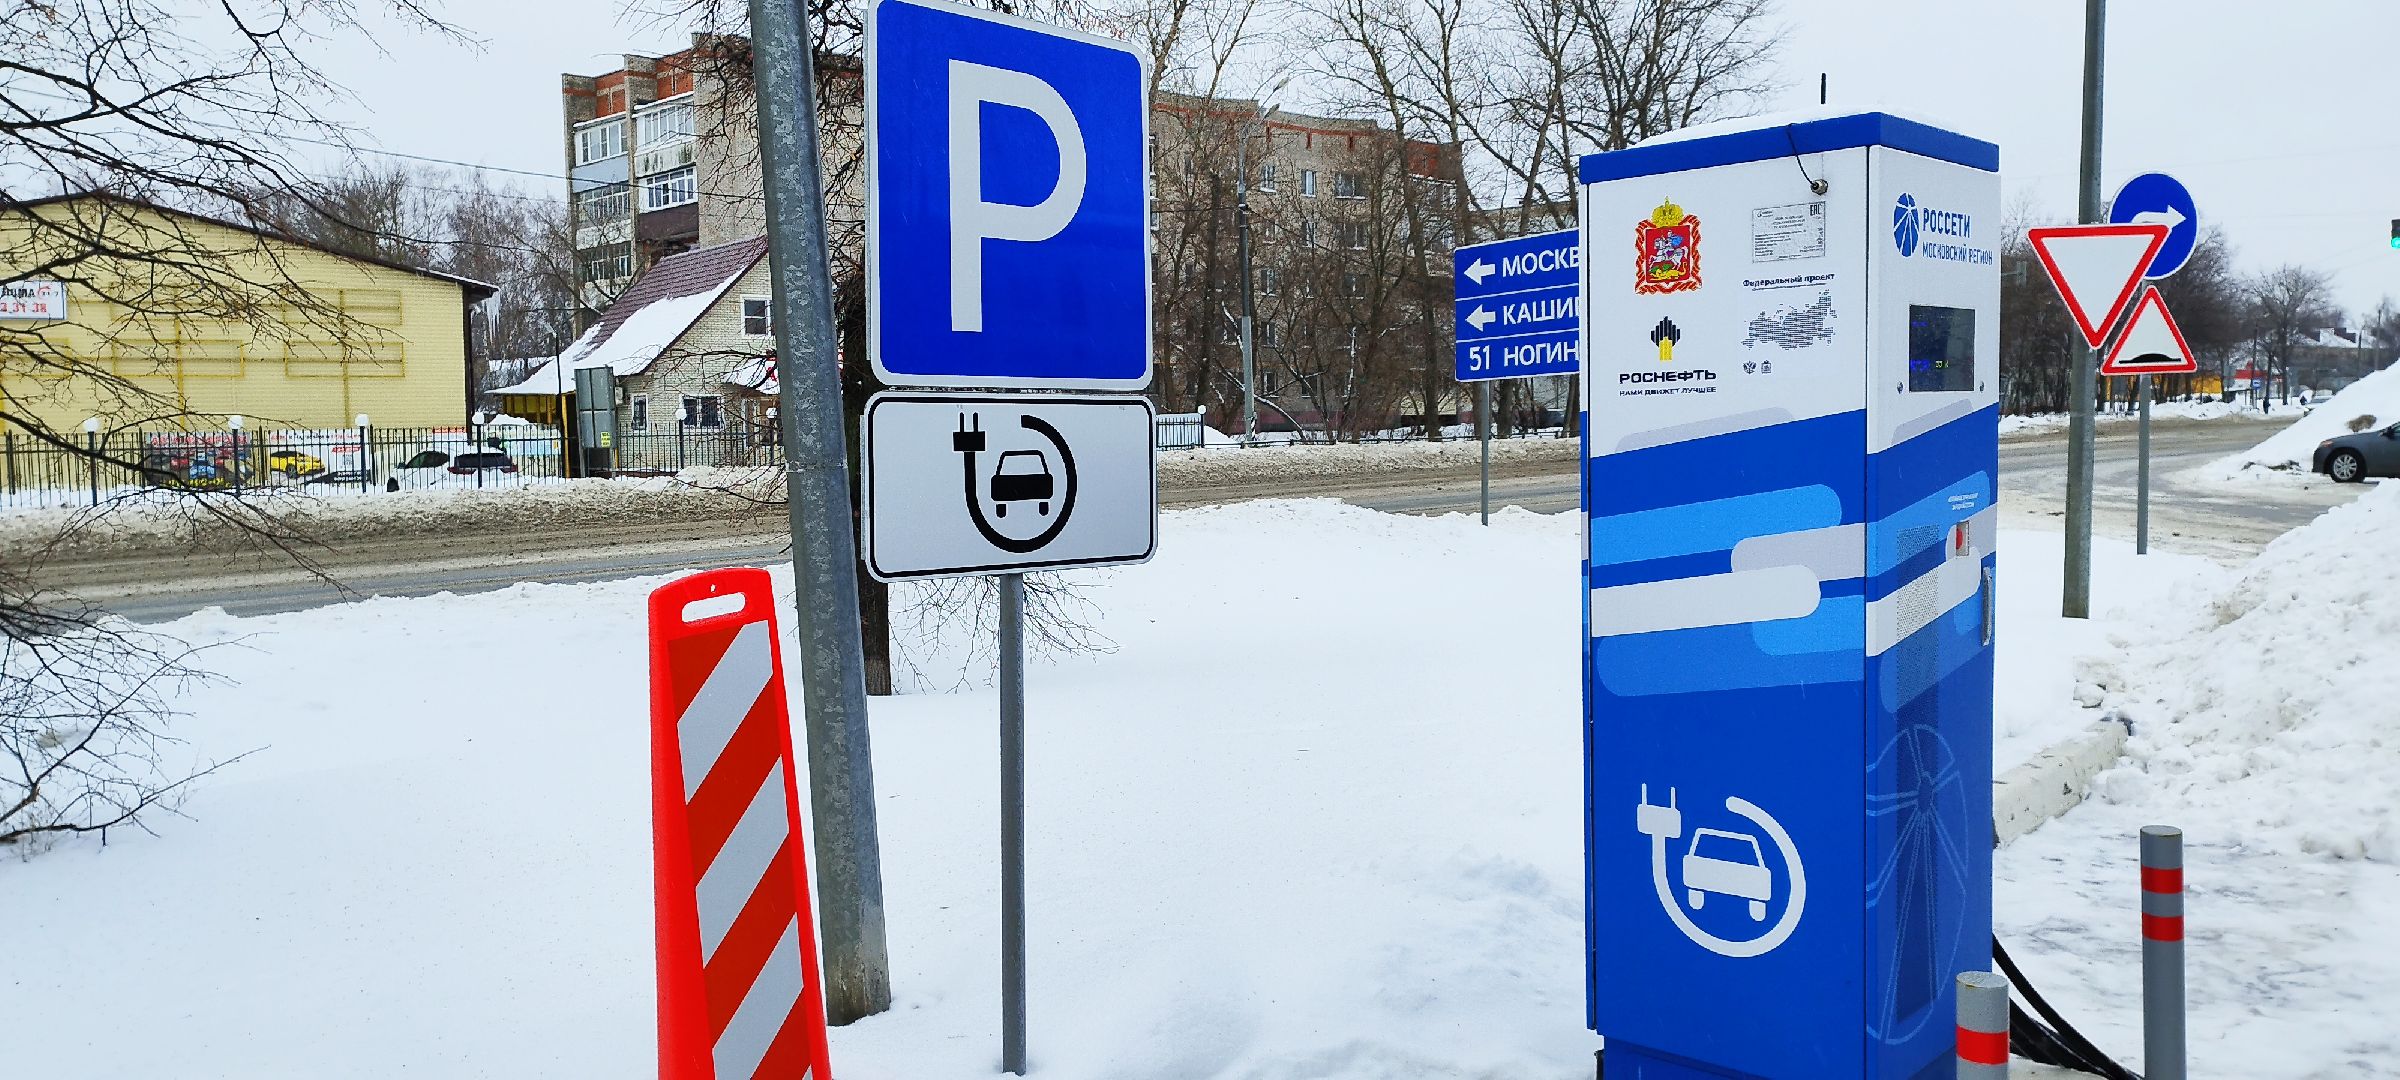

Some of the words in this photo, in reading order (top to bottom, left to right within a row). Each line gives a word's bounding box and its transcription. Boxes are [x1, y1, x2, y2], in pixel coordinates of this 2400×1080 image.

[949, 58, 1087, 333] P
[1923, 207, 1970, 238] РОССЕТИ
[1922, 241, 1967, 262] МОСКОВСКИЙ
[1968, 248, 1993, 266] РЕГИОН
[1743, 275, 1803, 287] Федеральный
[1804, 273, 1835, 283] проект
[1469, 345, 1490, 371] 51
[1619, 369, 1717, 384] РОСНЕФТЬ
[1644, 387, 1681, 396] ДВИЖЕТ
[1681, 386, 1717, 394] ЛУЧШЕЕ
